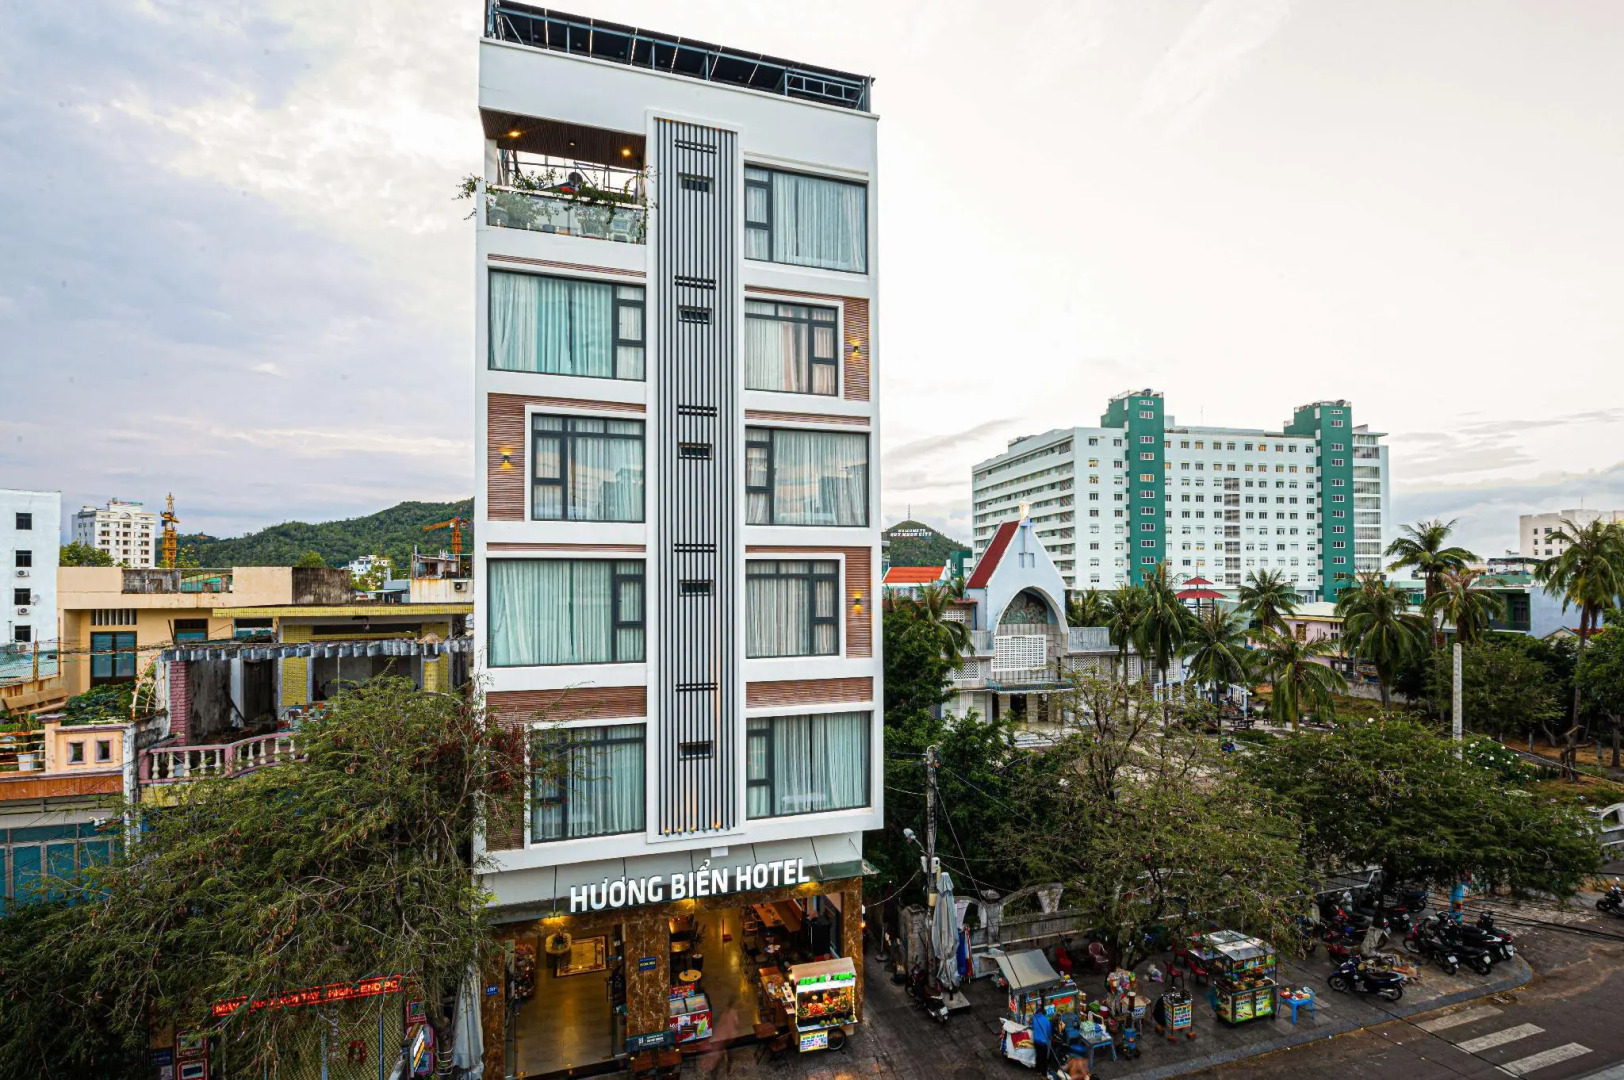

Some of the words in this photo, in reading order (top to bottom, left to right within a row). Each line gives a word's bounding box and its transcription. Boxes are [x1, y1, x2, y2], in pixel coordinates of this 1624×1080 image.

[570, 875, 663, 913] HƯƠNG
[671, 859, 728, 900] BIỂN
[736, 858, 810, 892] HOTEL
[383, 980, 398, 989] PC
